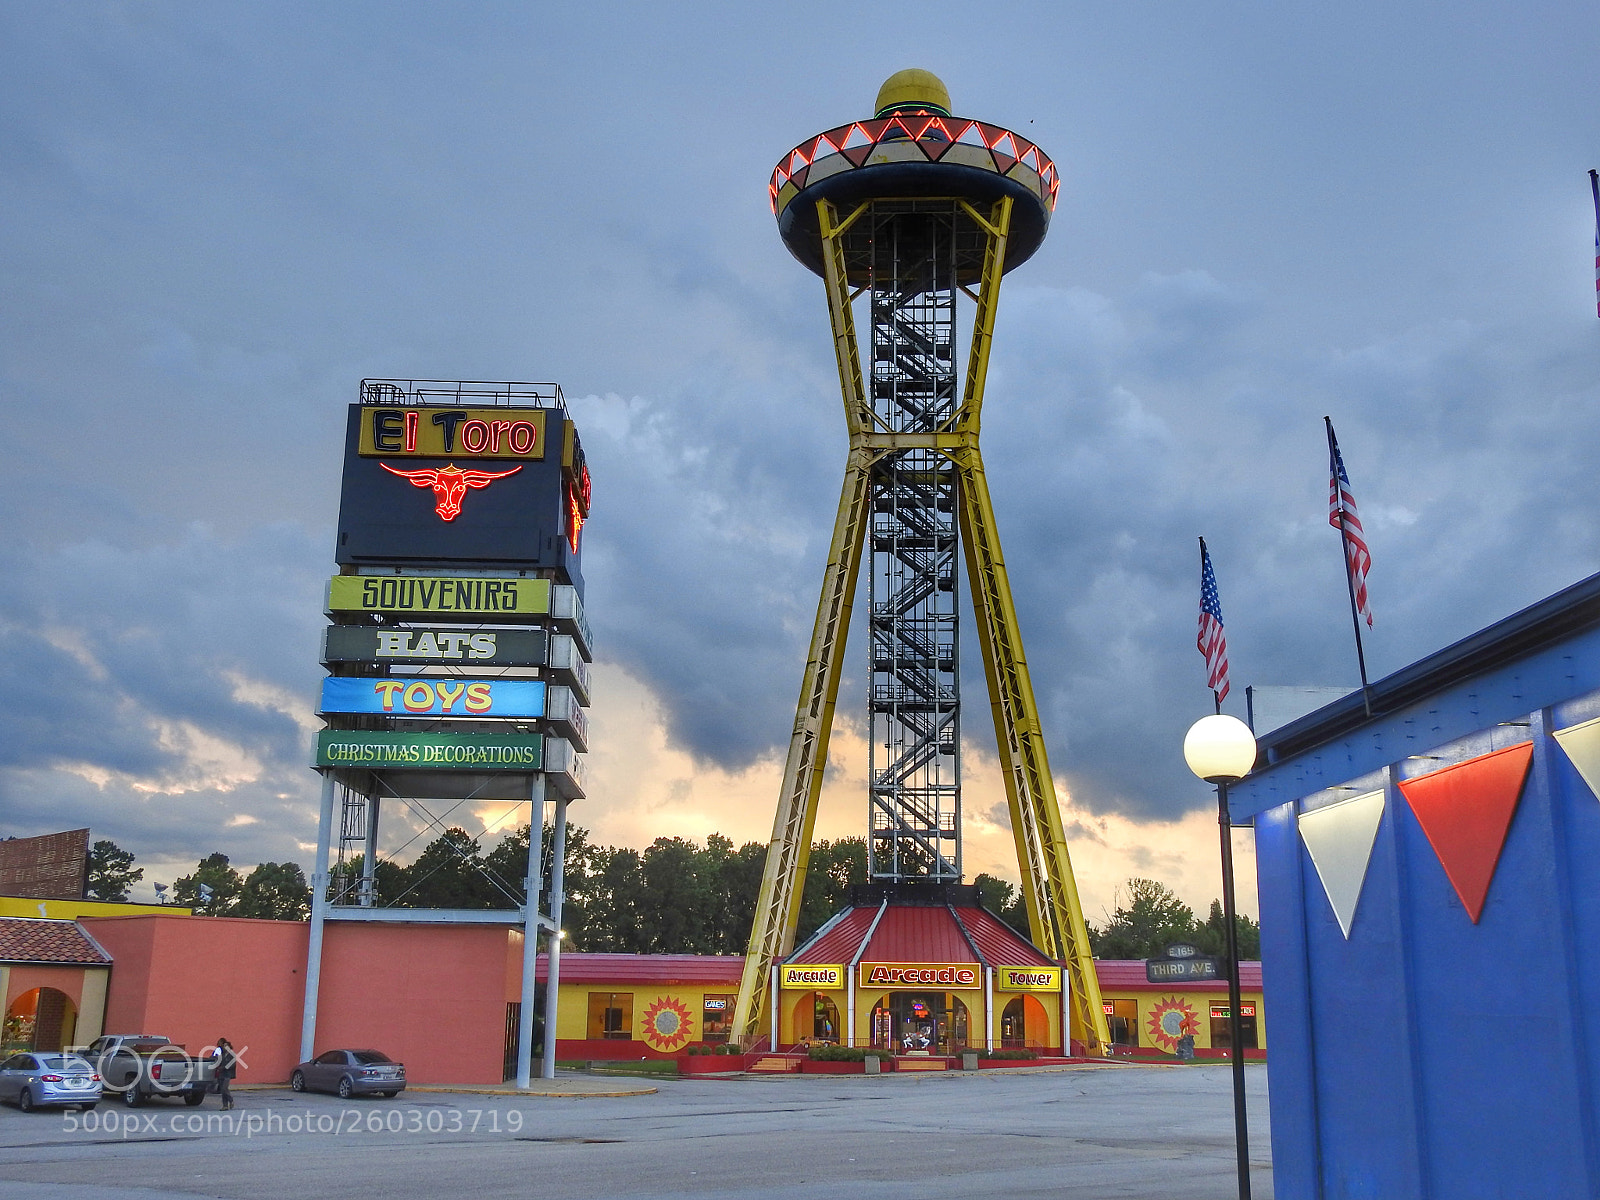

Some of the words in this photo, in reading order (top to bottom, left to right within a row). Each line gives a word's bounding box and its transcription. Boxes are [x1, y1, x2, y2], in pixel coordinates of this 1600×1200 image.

[373, 410, 419, 452] El
[432, 411, 537, 454] Toro
[363, 579, 518, 611] SOUVENIRS
[375, 631, 497, 659] HATS
[374, 681, 493, 713] TOYS
[327, 742, 420, 763] CHRISTMAS
[423, 744, 534, 764] DECORATIONS
[786, 968, 837, 983] Arcade
[868, 966, 975, 985] Arcade
[1009, 971, 1053, 986] Tower
[1151, 963, 1185, 976] THIRD
[1190, 962, 1216, 974] AVE.
